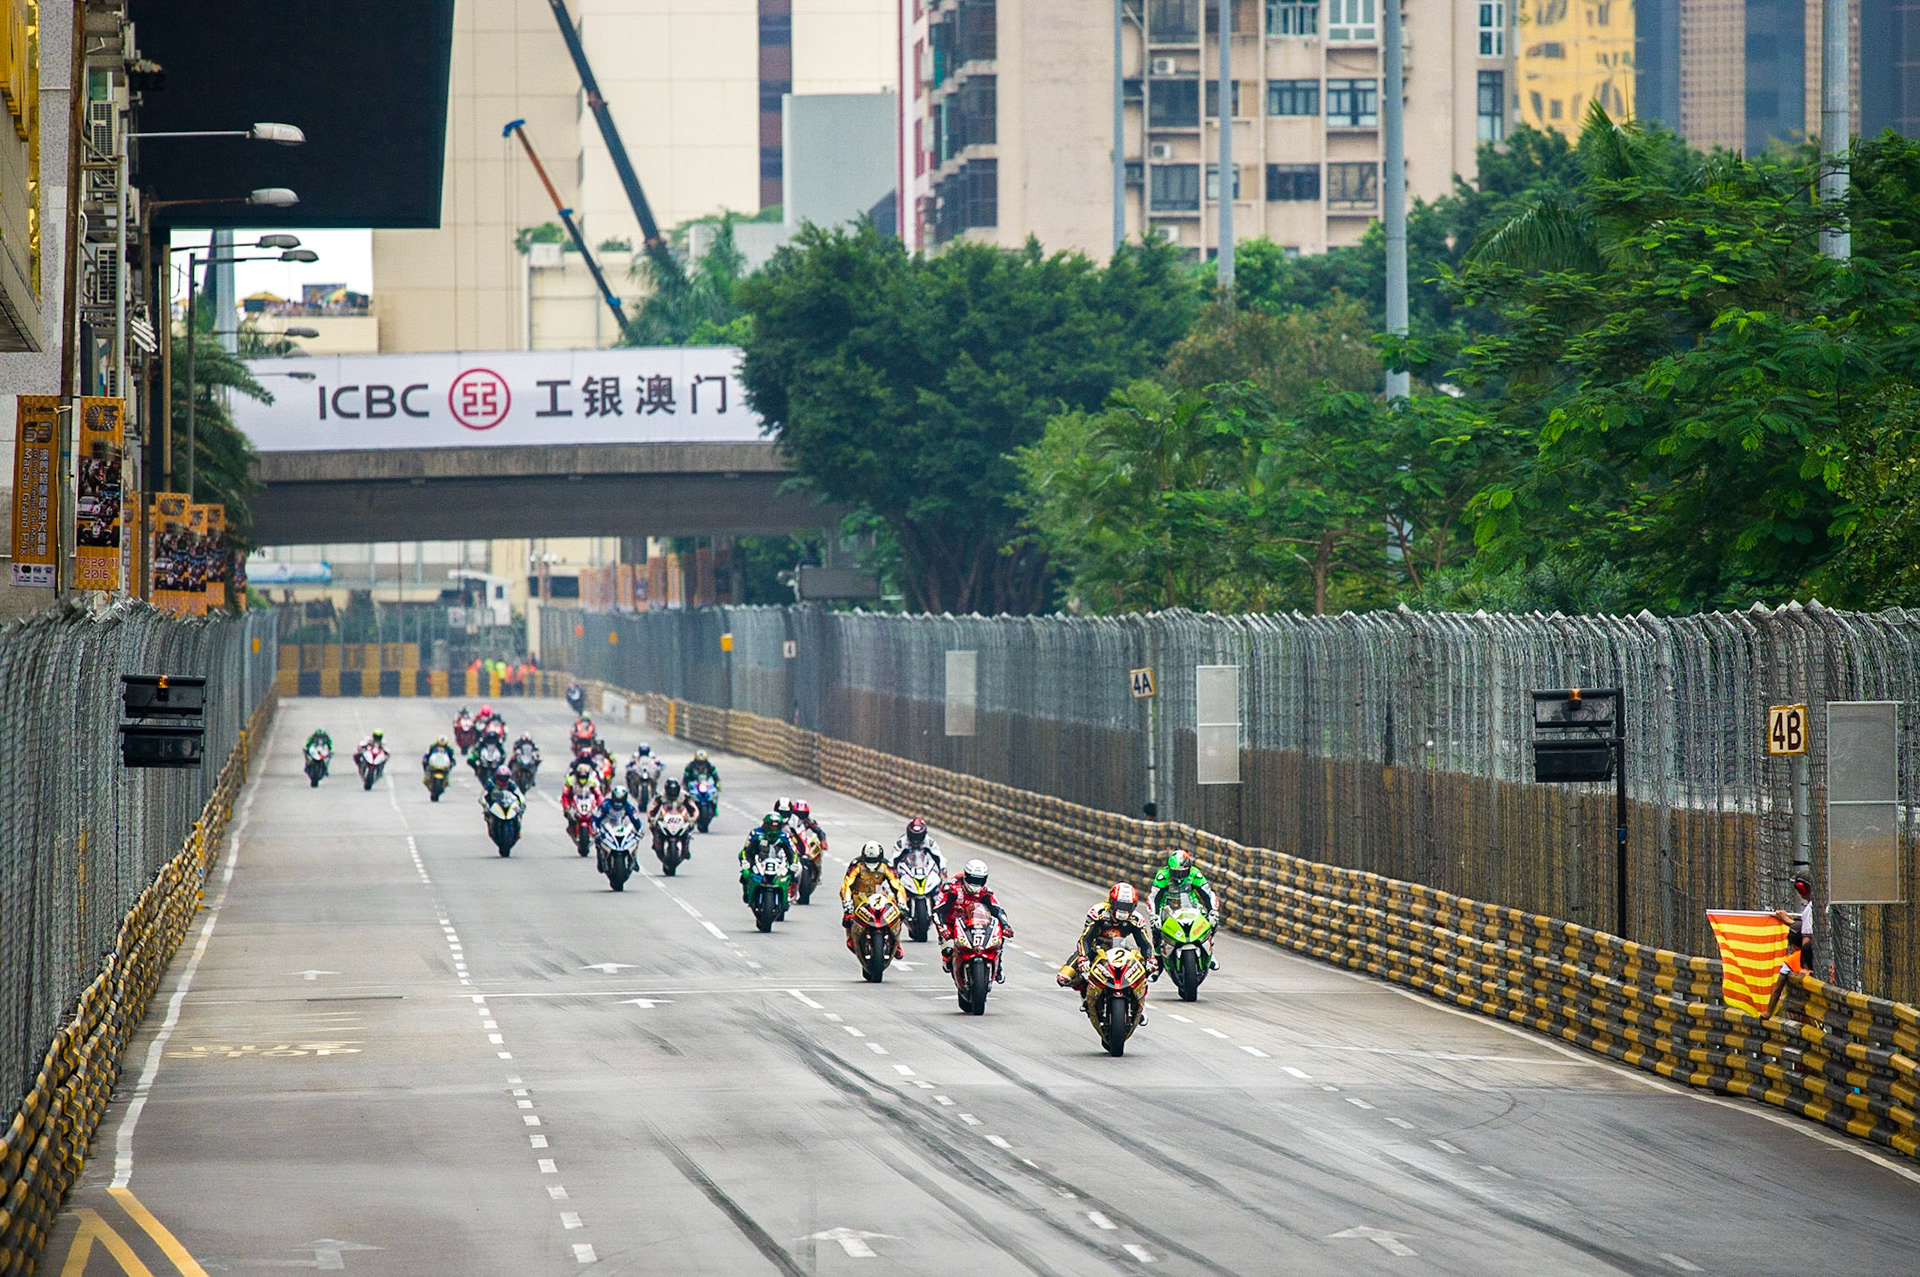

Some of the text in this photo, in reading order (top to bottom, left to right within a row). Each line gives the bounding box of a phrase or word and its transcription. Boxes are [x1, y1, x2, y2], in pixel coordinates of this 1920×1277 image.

[318, 383, 430, 420] ICBC
[535, 374, 728, 418] 工银澳门
[23, 421, 53, 443] 63
[21, 448, 33, 555] Macau Grand Prix
[84, 569, 109, 580] 2016
[1133, 672, 1153, 695] 4A
[1773, 710, 1802, 751] 4B
[1112, 950, 1125, 963] 2
